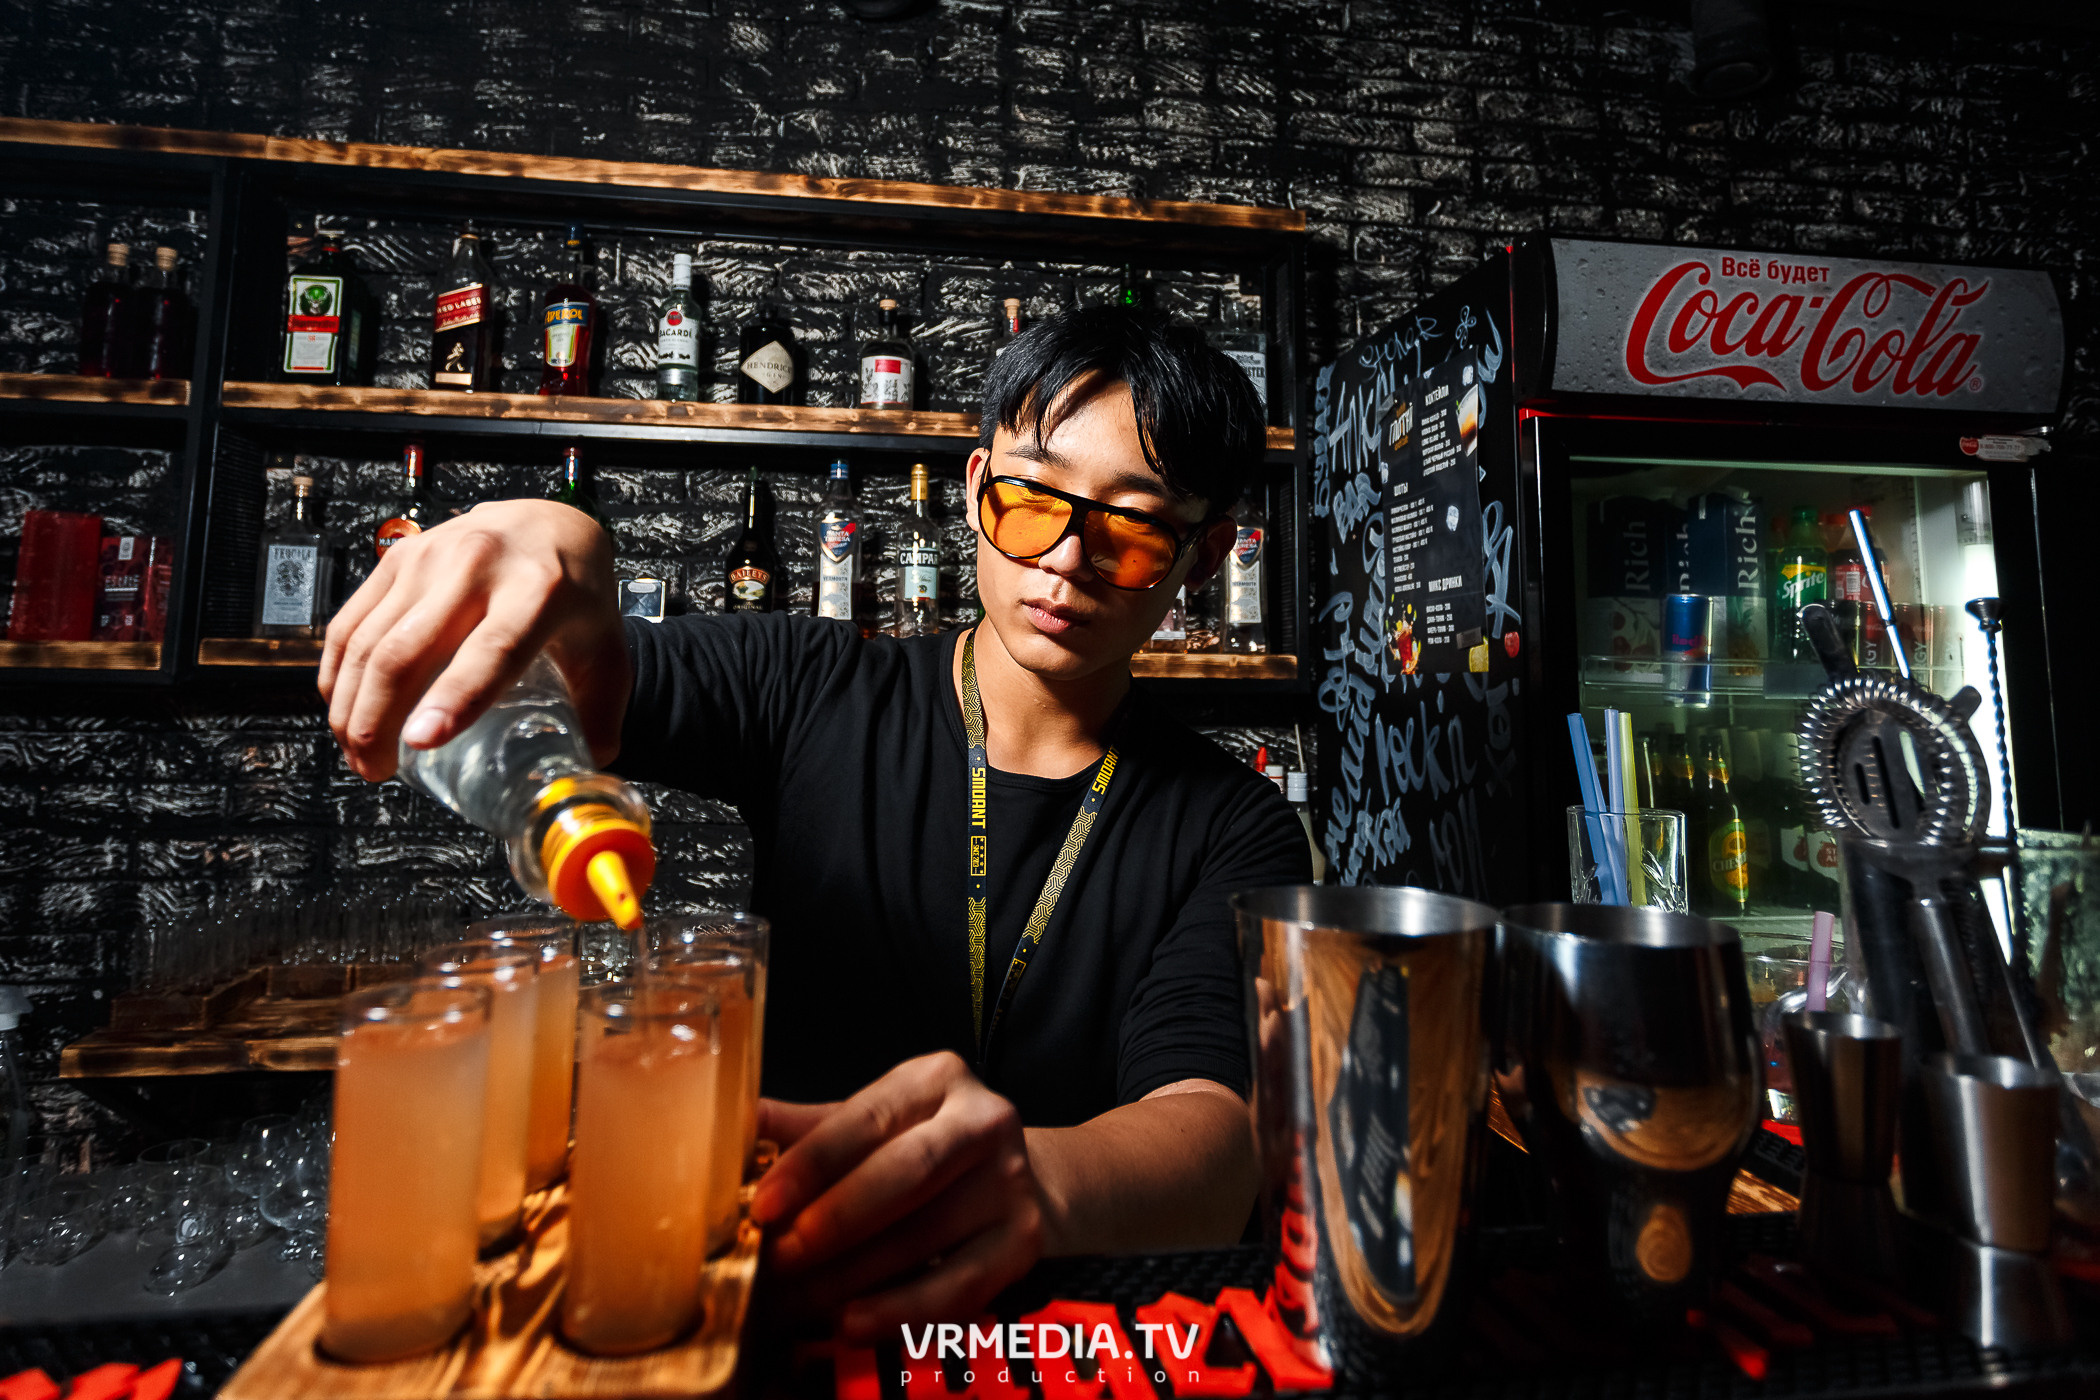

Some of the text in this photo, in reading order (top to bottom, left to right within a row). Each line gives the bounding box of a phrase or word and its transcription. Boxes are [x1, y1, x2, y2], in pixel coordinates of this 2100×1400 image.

[1721, 256, 1830, 284] Всё будет
[544, 308, 583, 325] APEROL
[1626, 261, 1988, 396] Coca-Cola
[1622, 519, 1651, 592] Rich
[1735, 515, 1760, 590] Rich
[1781, 571, 1824, 599] Sprite
